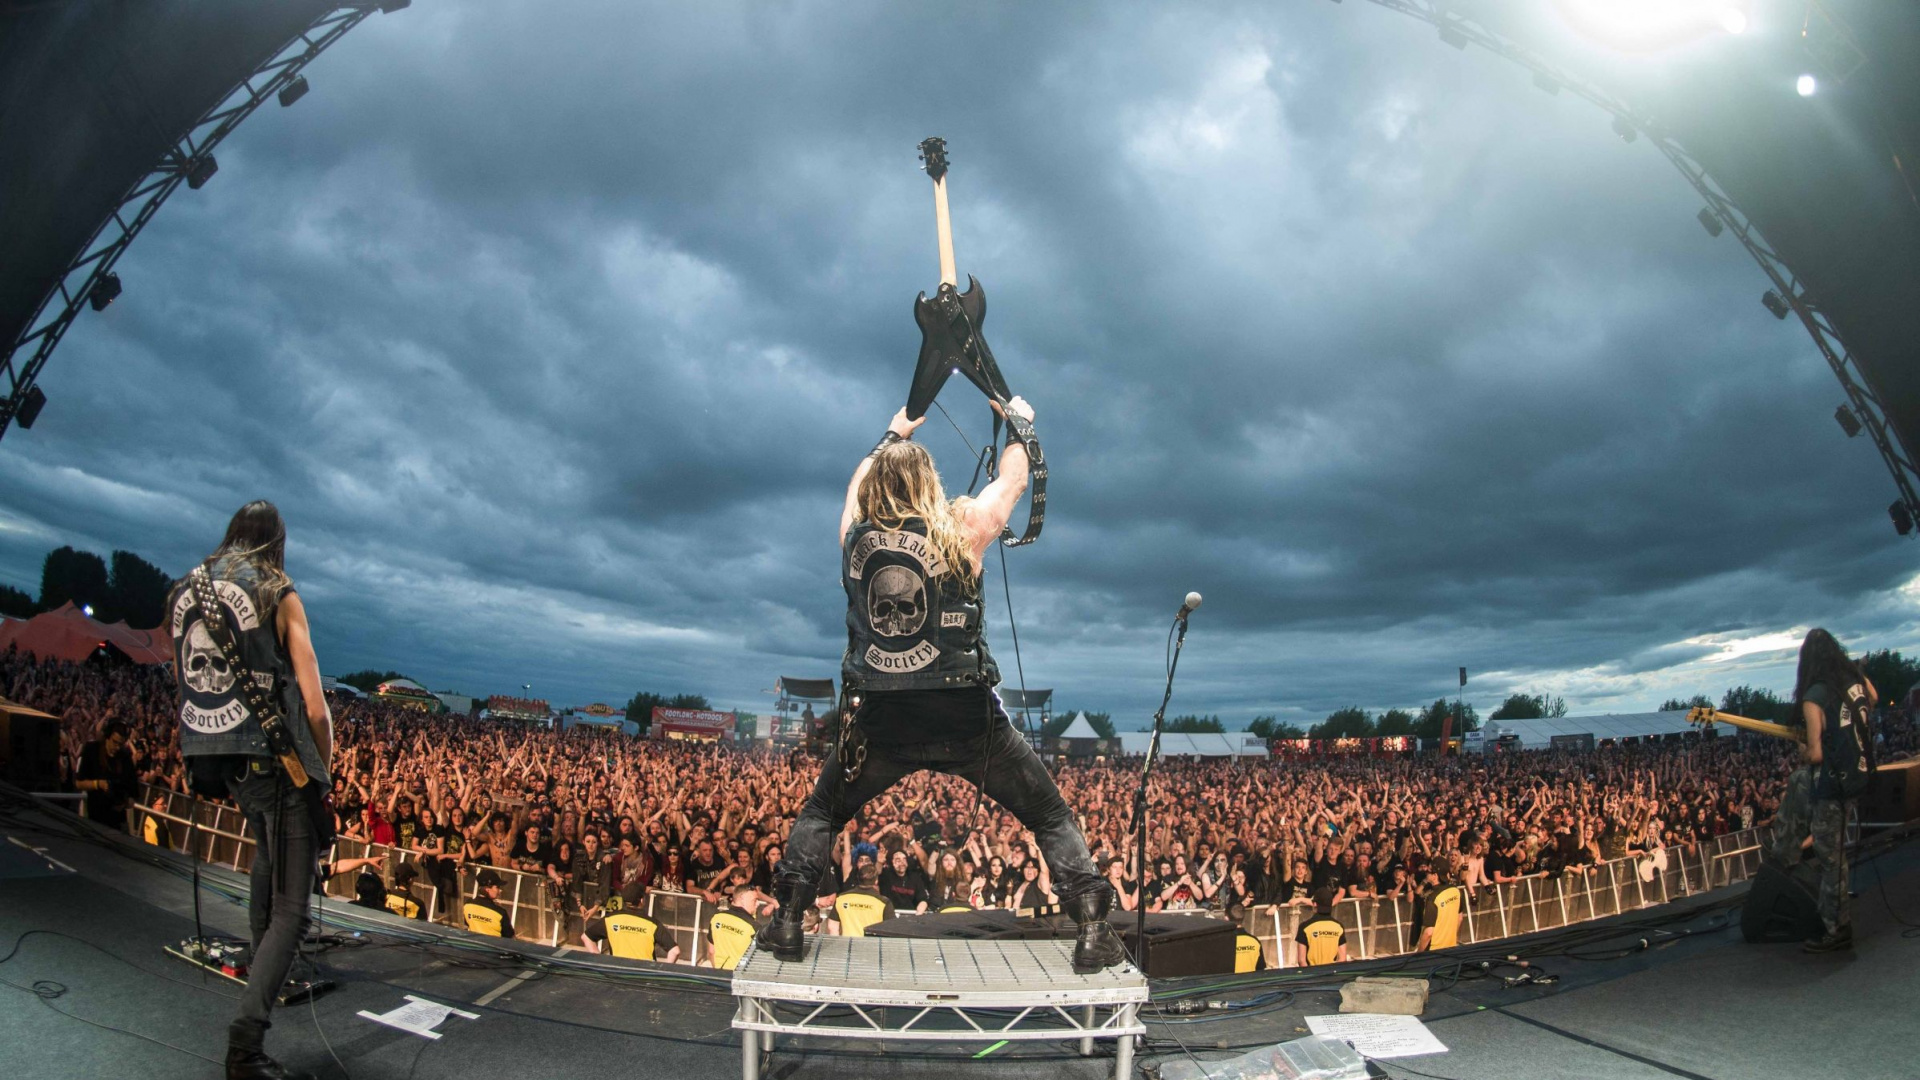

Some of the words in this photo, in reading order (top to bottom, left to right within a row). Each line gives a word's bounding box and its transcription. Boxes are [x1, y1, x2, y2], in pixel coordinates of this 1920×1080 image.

[851, 533, 888, 572] Black
[217, 582, 256, 625] Label
[867, 643, 936, 669] Society
[183, 702, 245, 729] Society
[665, 709, 693, 718] FOOTLONG
[697, 712, 723, 720] HOTDOGS
[611, 899, 619, 910] 3
[472, 914, 492, 923] SHOWSEC
[619, 924, 647, 933] SHOWSEC
[721, 923, 744, 935] SHOWSEC
